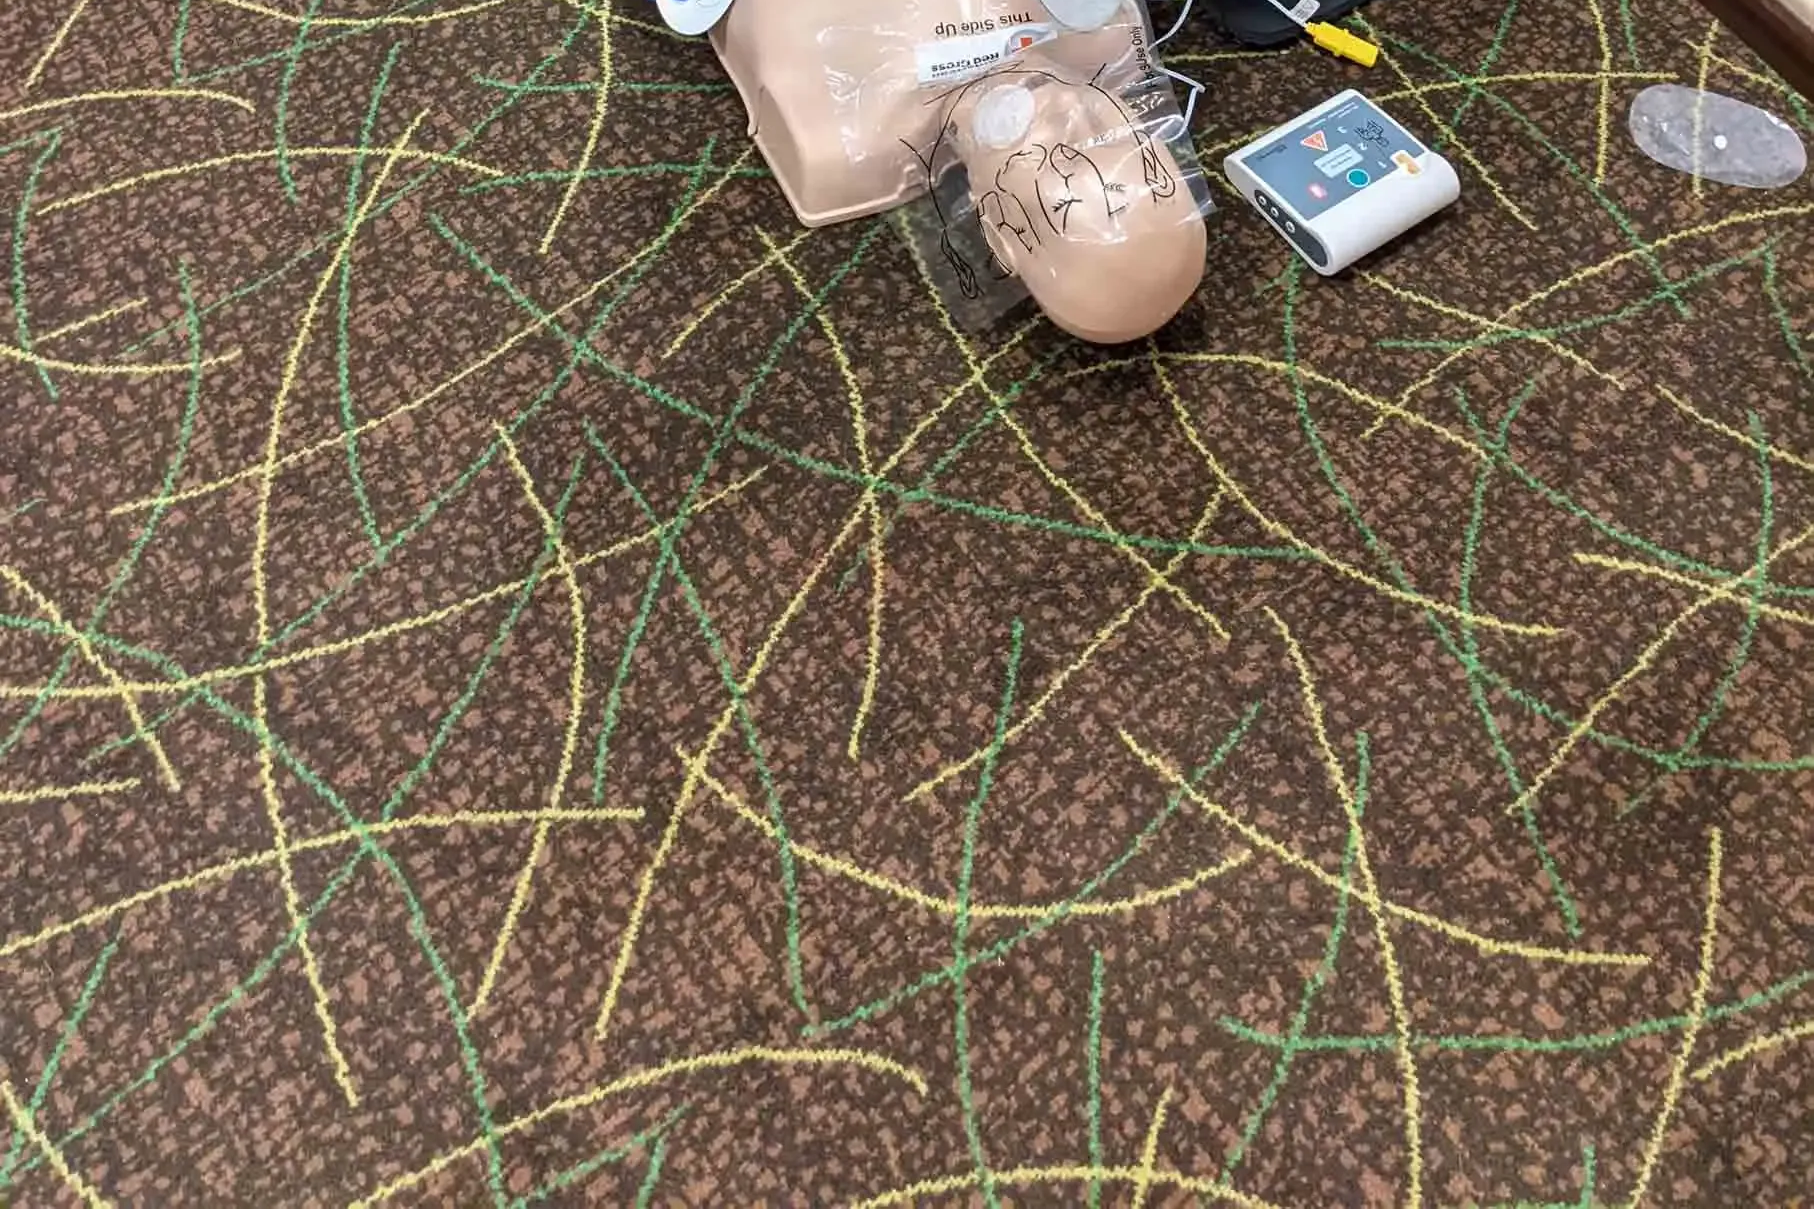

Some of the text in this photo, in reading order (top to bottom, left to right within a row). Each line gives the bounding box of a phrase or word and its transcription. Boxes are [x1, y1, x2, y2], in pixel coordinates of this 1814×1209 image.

[935, 11, 1033, 37] This Side Up
[1129, 26, 1143, 45] Only
